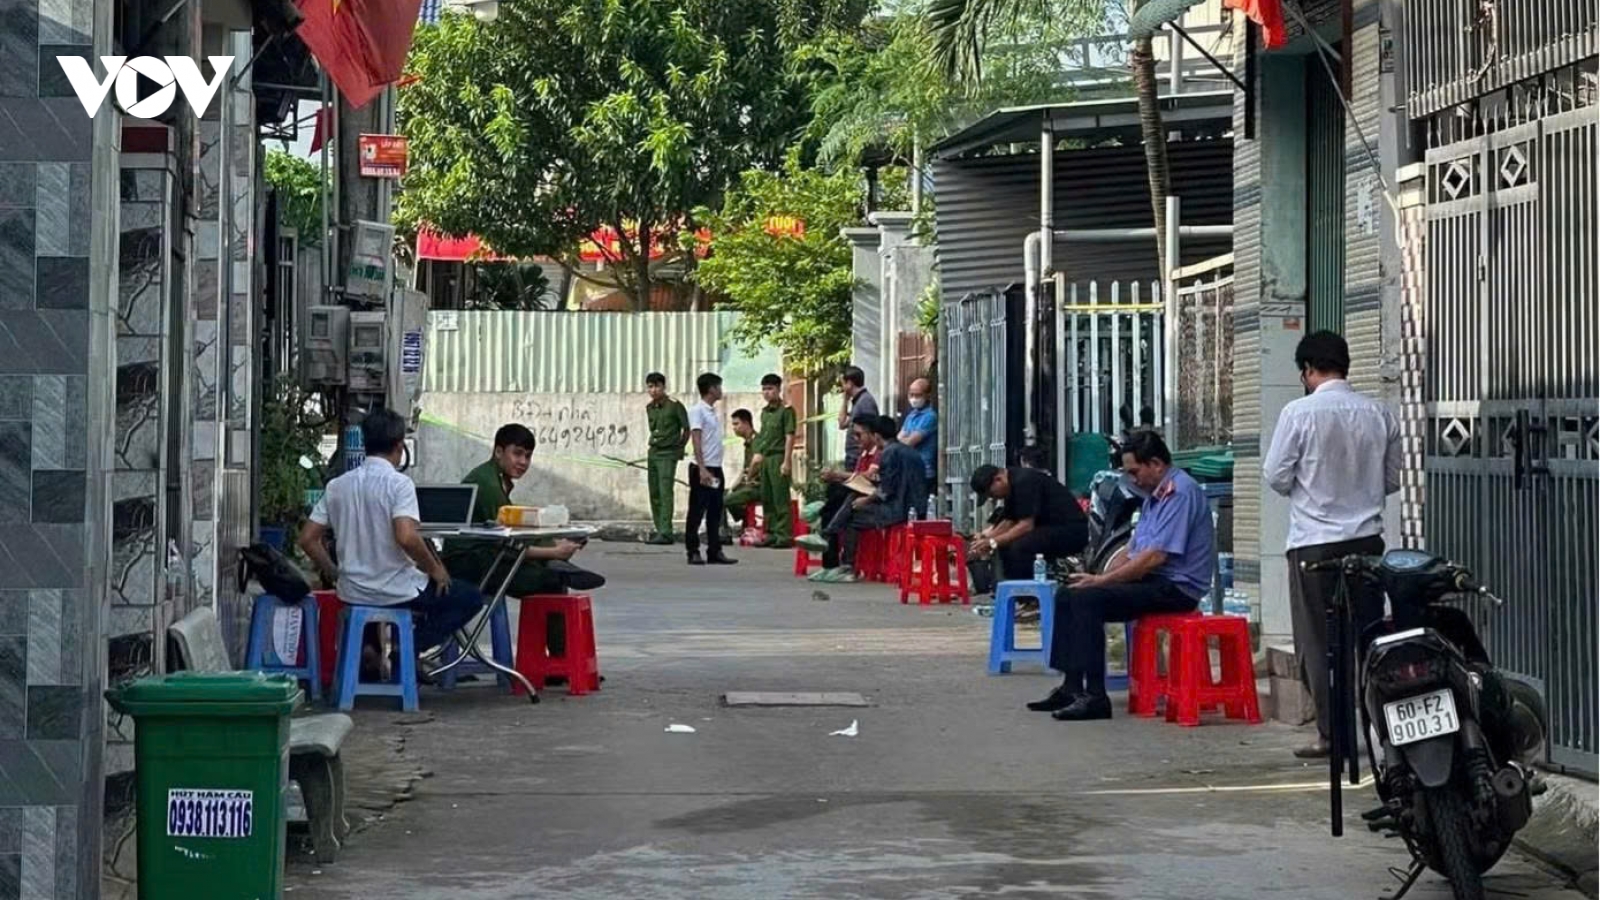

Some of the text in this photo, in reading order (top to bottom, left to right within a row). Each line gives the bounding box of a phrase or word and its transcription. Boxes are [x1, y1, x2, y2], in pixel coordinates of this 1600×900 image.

[1396, 695, 1444, 721] 60-F2
[1393, 711, 1454, 741] 900.31
[169, 800, 252, 837] 0938.113.116
